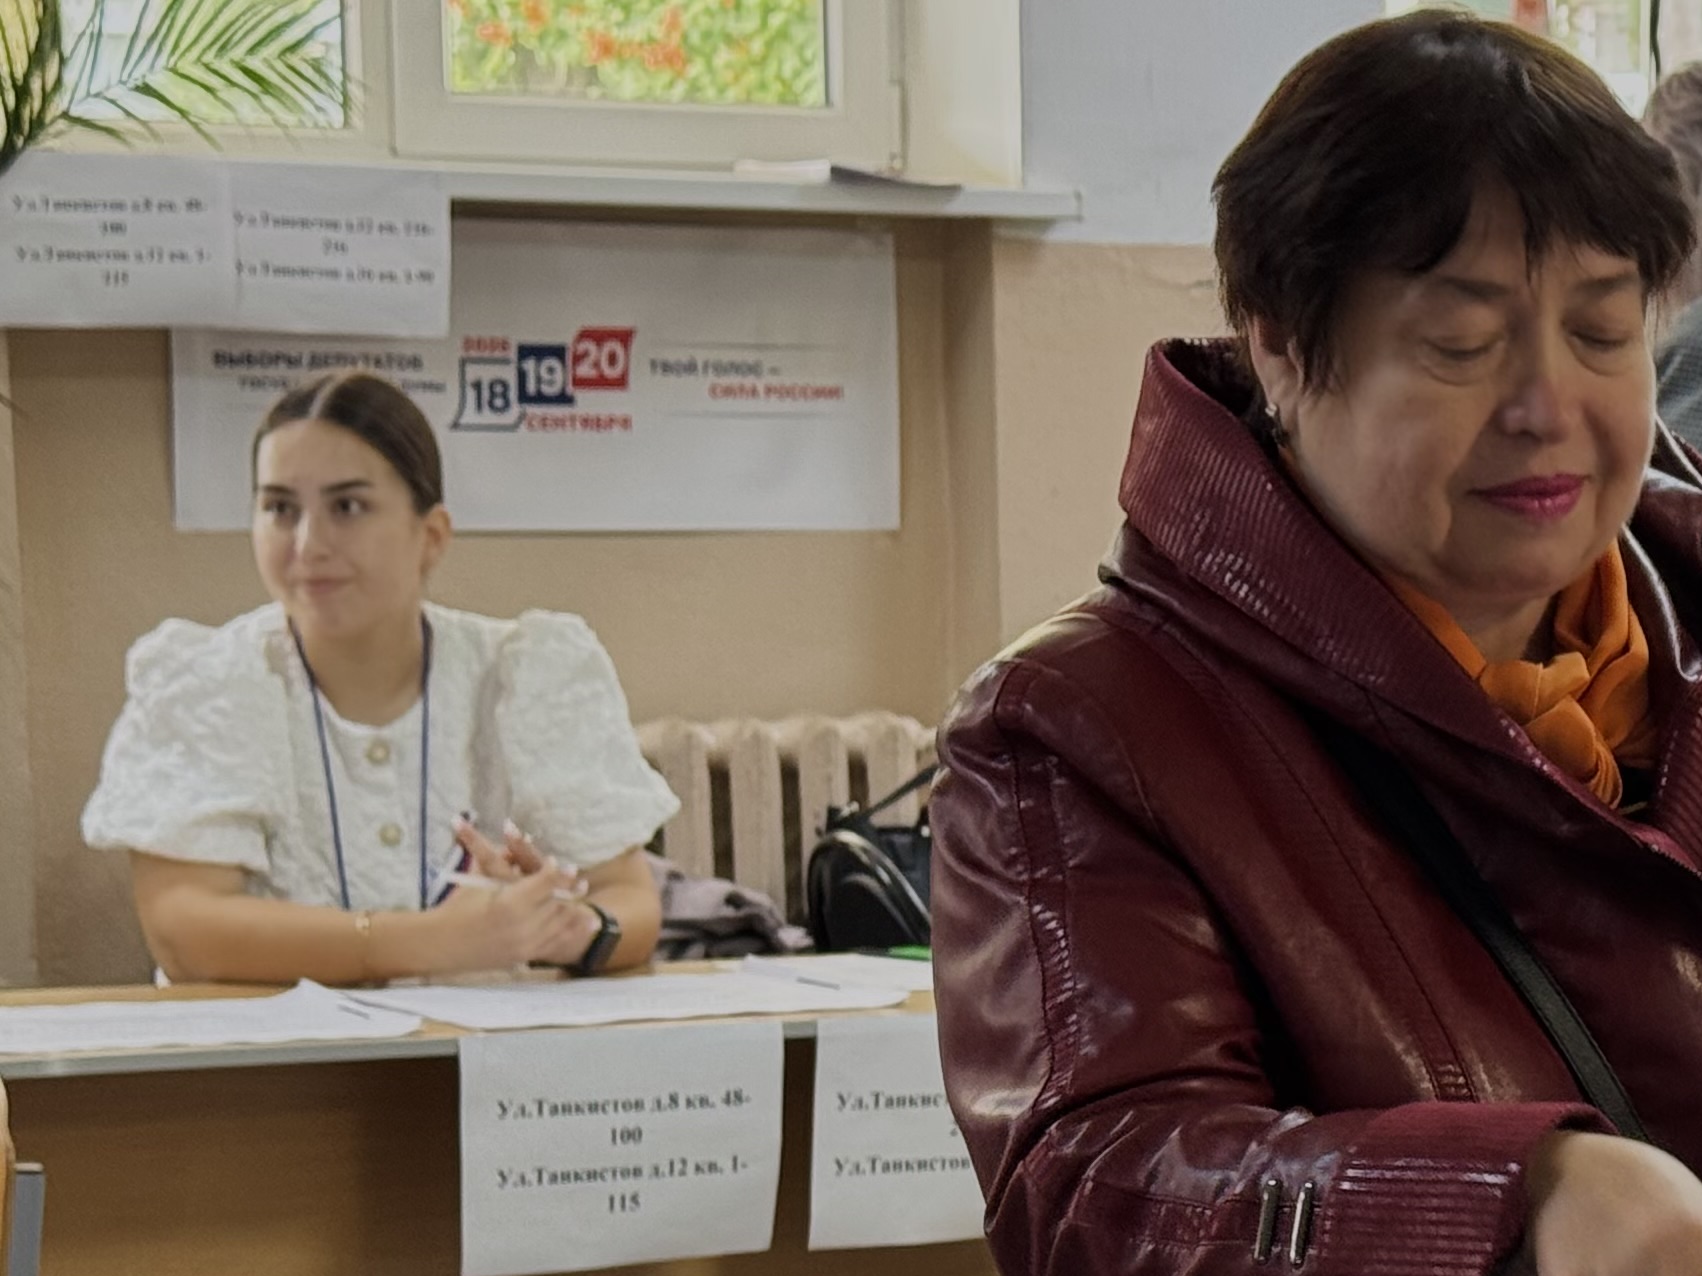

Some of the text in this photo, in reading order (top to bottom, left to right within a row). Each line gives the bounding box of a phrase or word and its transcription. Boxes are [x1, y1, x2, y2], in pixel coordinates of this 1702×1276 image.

[213, 350, 302, 370] ВЫБОРЫ
[575, 337, 626, 380] 20
[521, 355, 566, 398] 19
[470, 377, 512, 415] 18
[497, 1096, 646, 1121] Ул.Танкистов
[836, 1089, 947, 1113] Ул.Танкис
[610, 1125, 643, 1147] 100
[497, 1164, 644, 1190] Ул.Танкистов
[650, 1156, 688, 1181] д.12
[608, 1191, 642, 1215] 115
